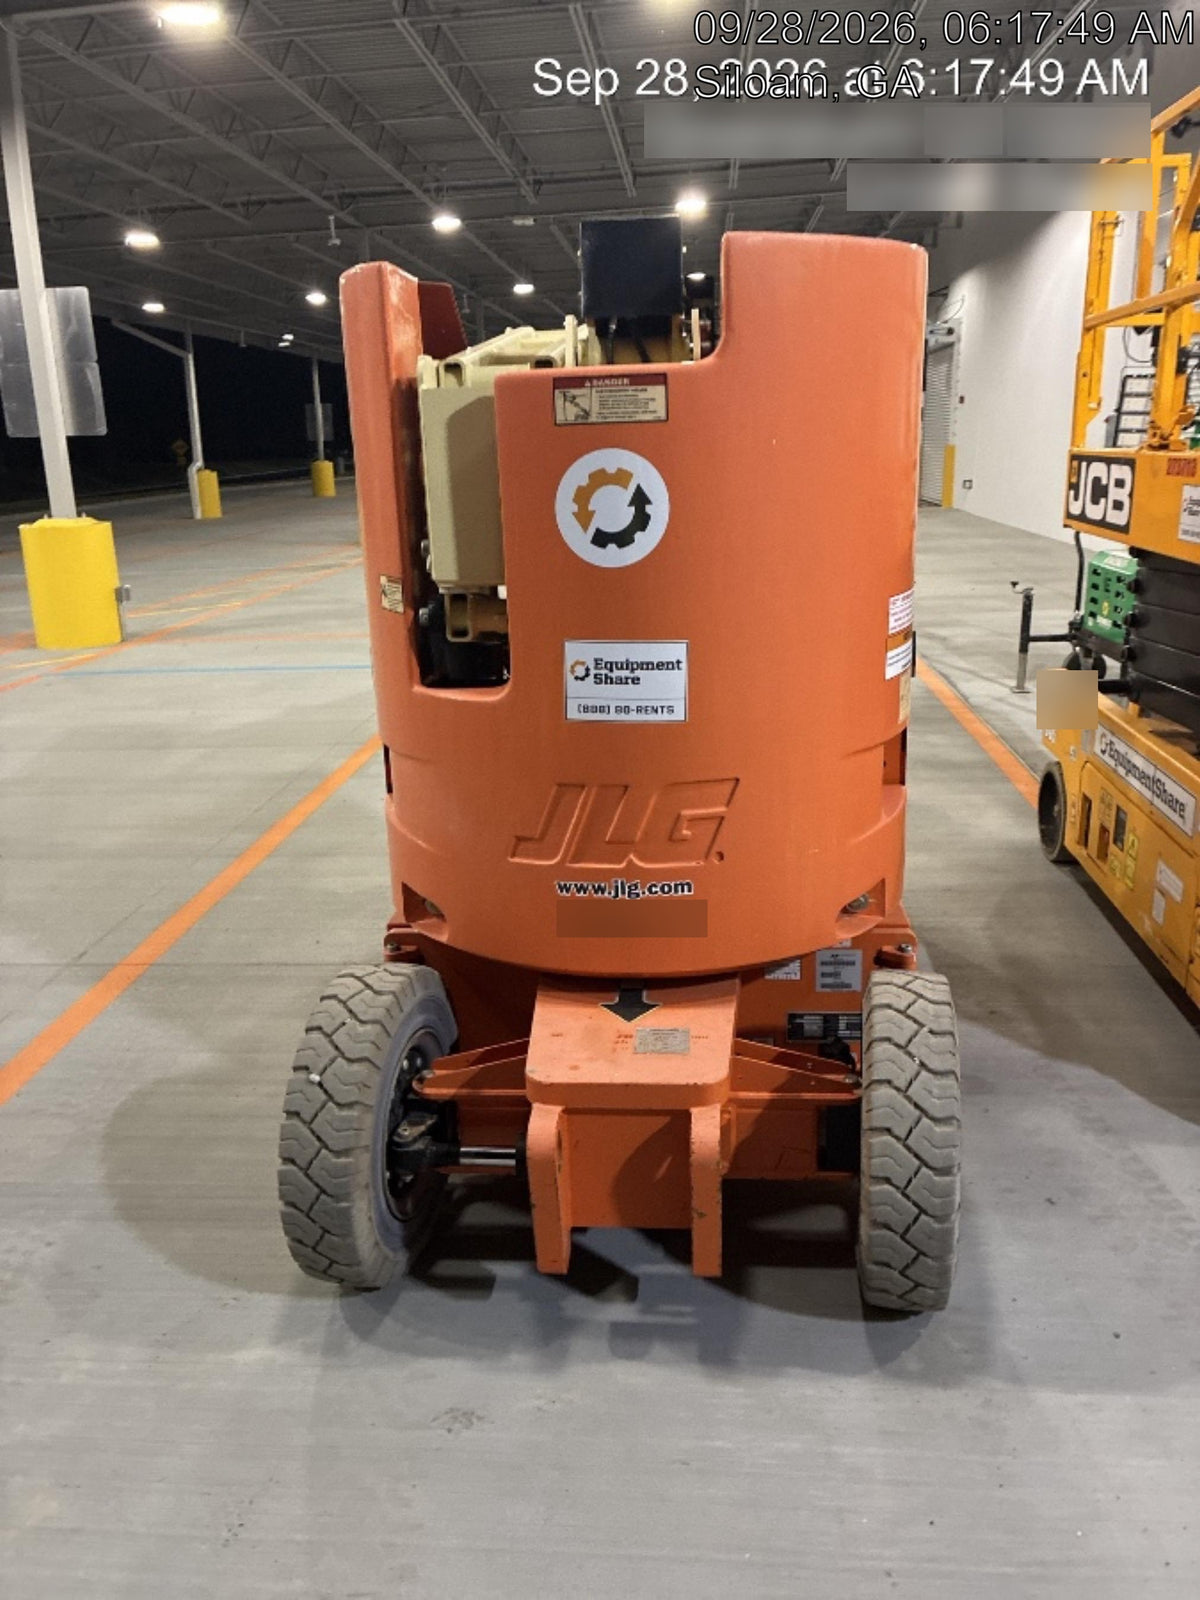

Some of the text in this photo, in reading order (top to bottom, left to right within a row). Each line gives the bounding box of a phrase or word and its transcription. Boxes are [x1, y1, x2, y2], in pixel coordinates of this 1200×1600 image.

[1068, 461, 1133, 526] JCB
[593, 658, 682, 674] Equipment
[593, 672, 641, 685] Share
[507, 777, 740, 868] JLG
[556, 880, 693, 899] www.jlg.com
